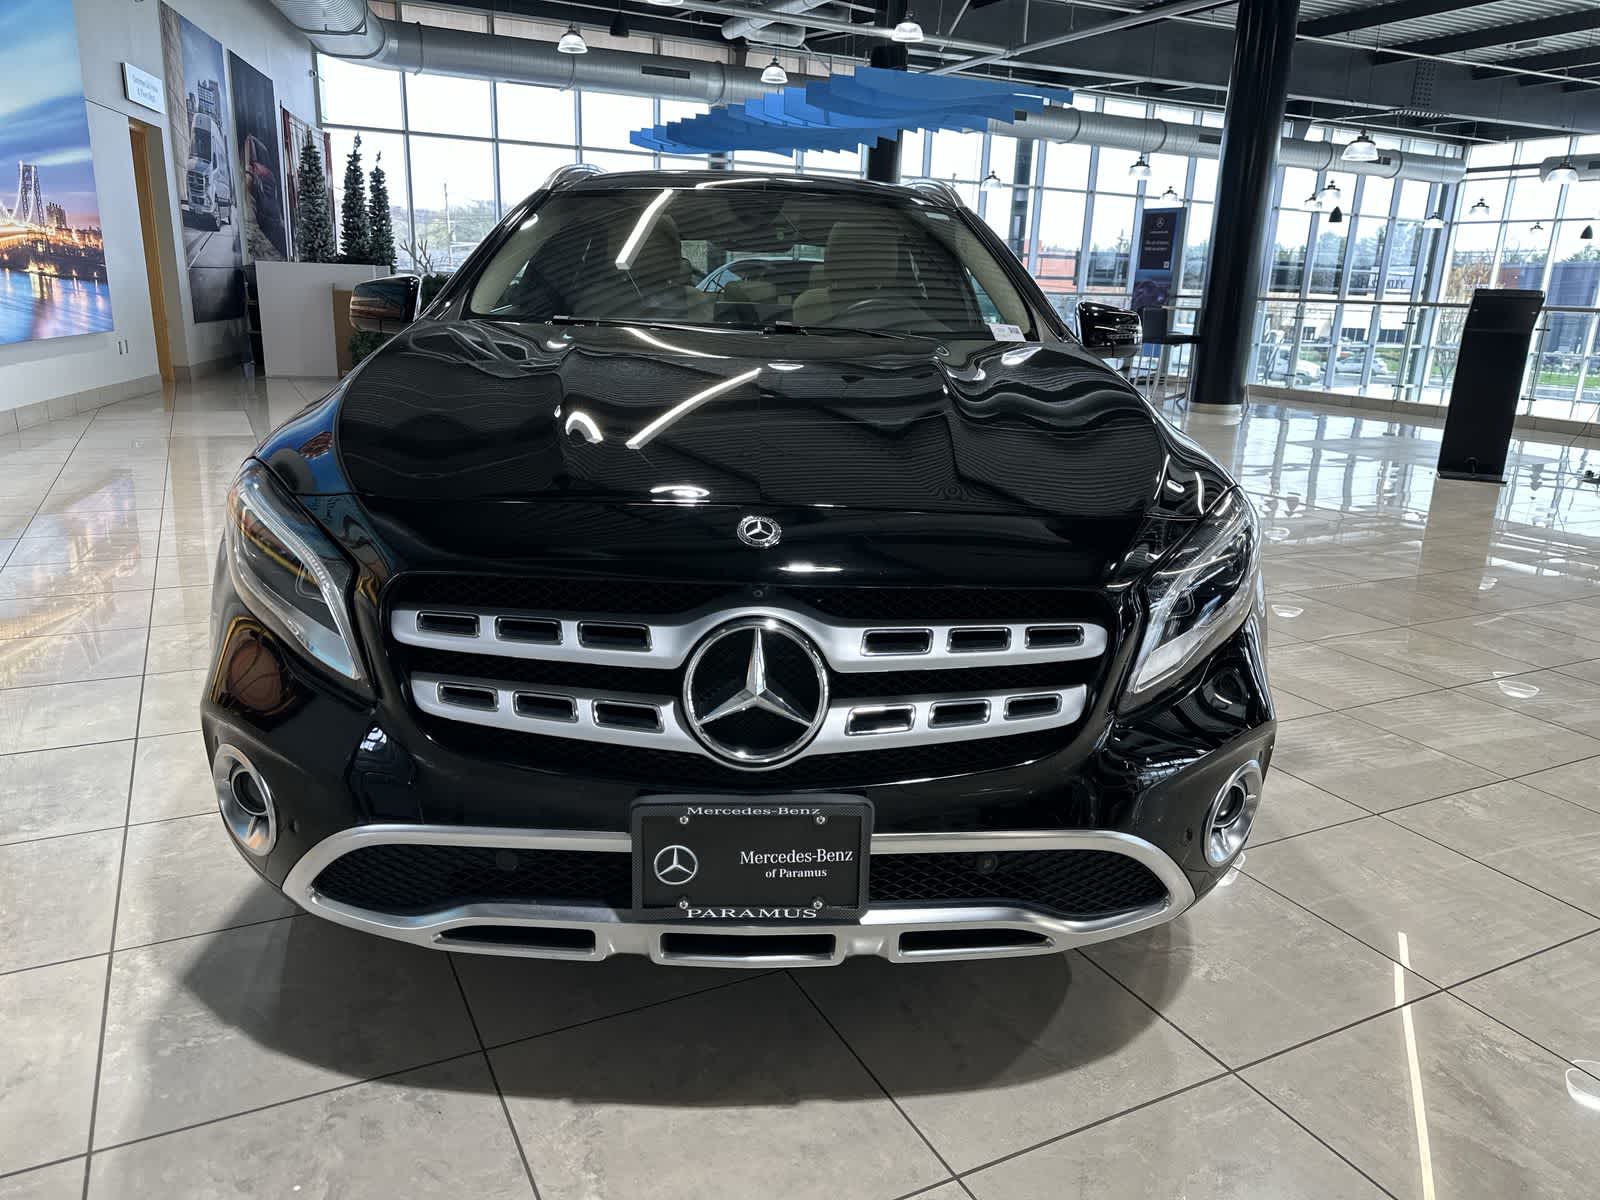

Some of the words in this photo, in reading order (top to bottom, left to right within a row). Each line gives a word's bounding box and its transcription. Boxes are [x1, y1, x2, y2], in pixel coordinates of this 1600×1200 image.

[687, 807, 821, 815] Mercedes-Benz
[740, 849, 853, 864] Mercedes-Benz
[765, 869, 777, 878] of
[779, 868, 828, 878] Paramus
[687, 908, 817, 918] PARAMUS
